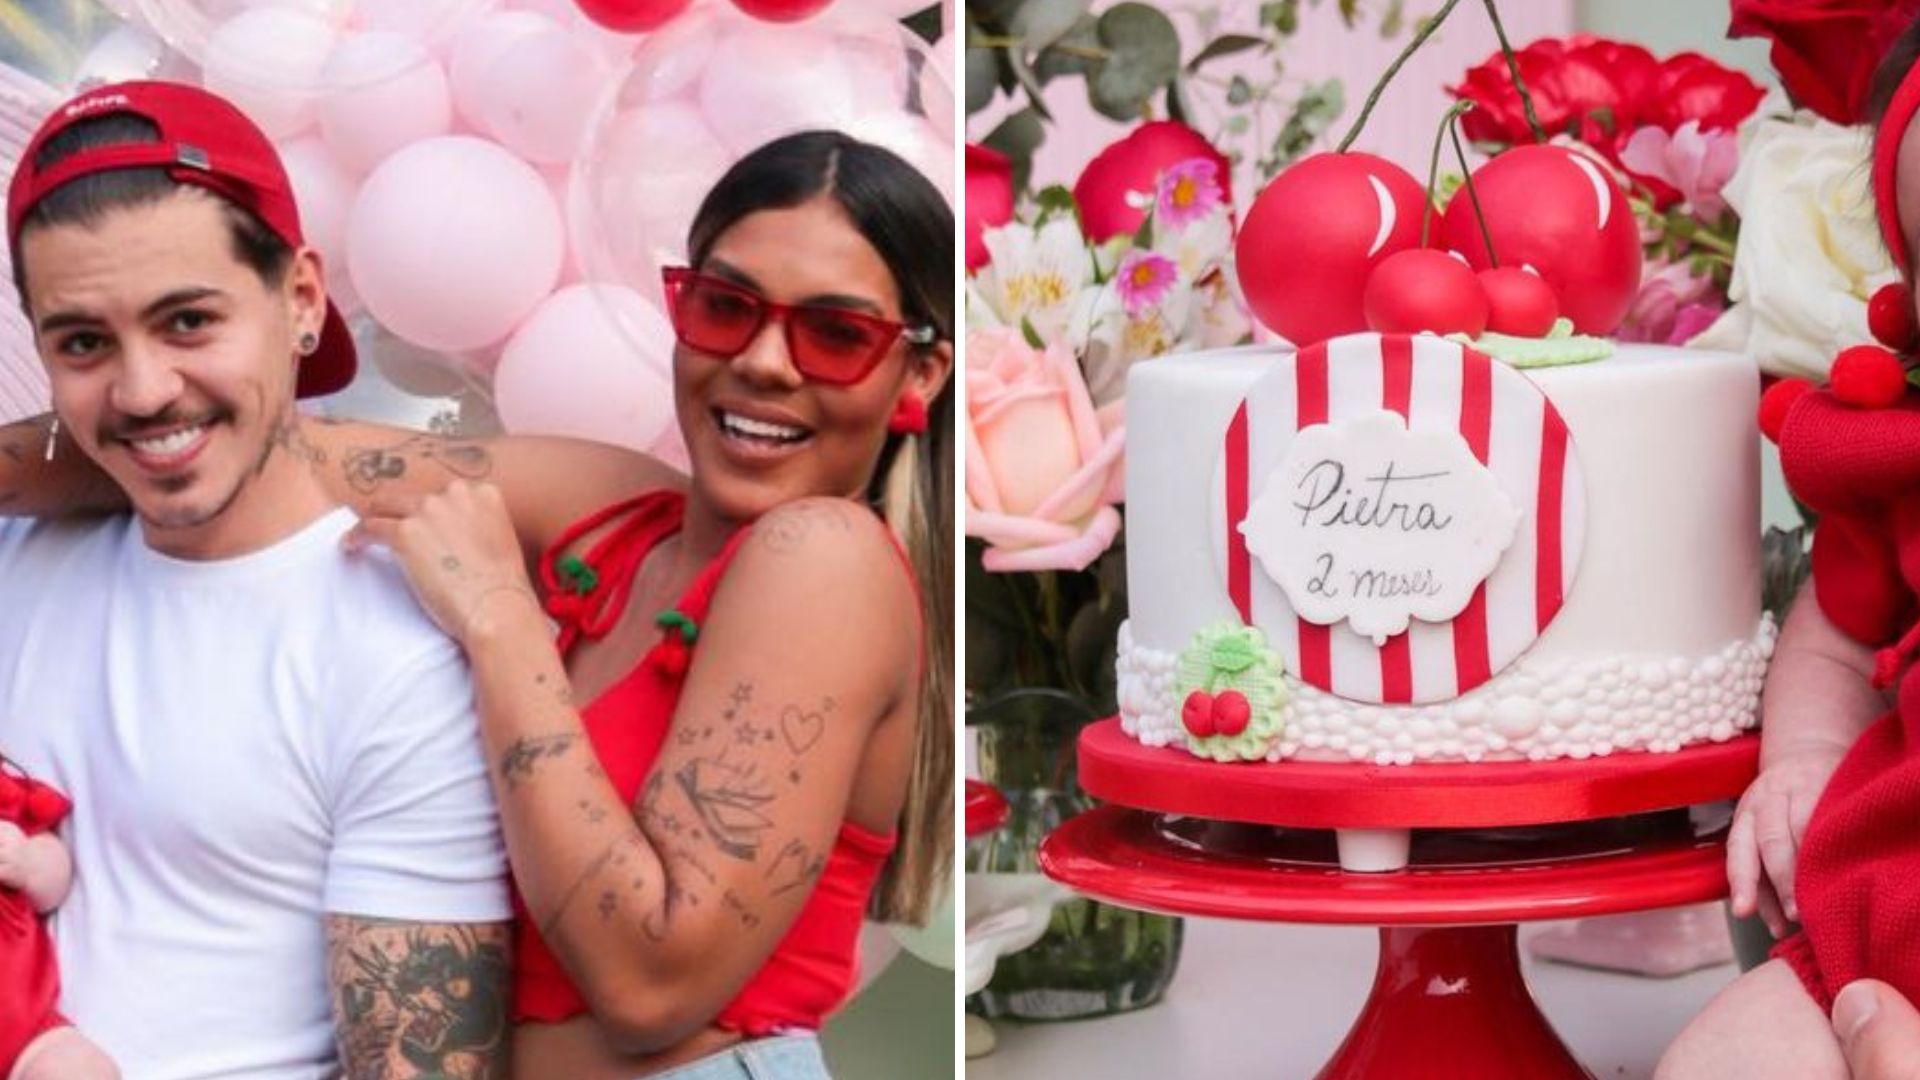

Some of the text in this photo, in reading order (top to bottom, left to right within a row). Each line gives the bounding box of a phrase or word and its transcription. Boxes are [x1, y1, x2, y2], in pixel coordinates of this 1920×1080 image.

[1294, 460, 1453, 531] Pietra
[1308, 553, 1443, 599] 2 meses
